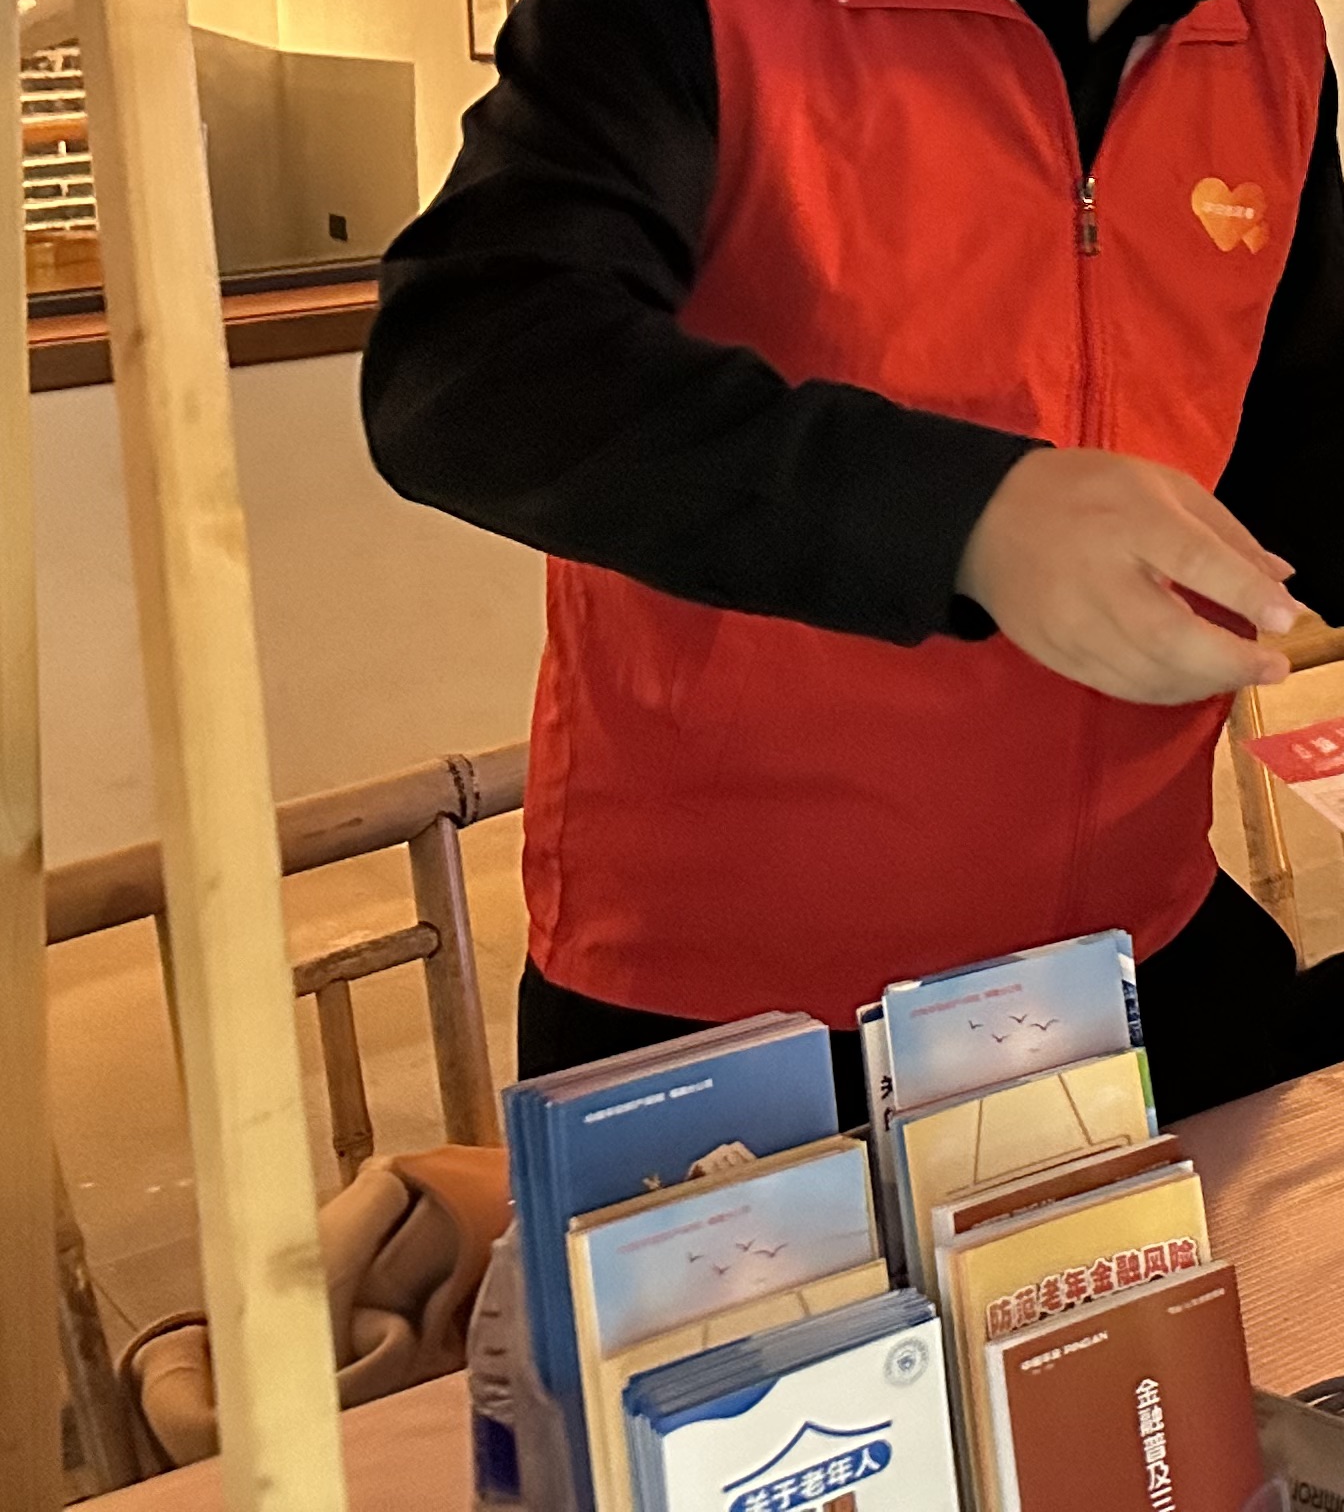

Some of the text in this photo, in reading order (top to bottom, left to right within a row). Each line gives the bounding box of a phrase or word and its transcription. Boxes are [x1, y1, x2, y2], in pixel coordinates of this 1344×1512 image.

[987, 1238, 1198, 1338] 防范老年金融风险
